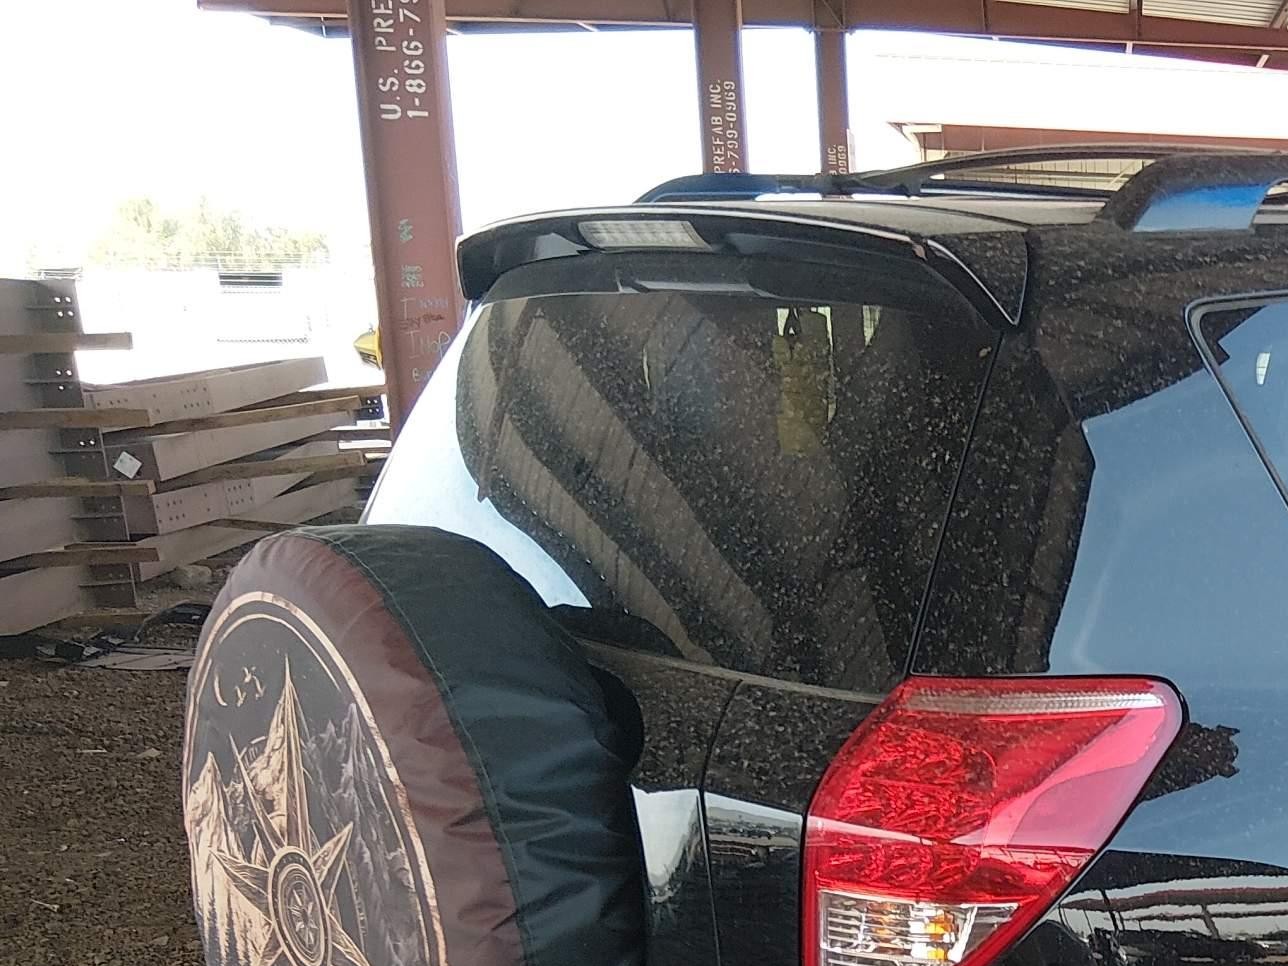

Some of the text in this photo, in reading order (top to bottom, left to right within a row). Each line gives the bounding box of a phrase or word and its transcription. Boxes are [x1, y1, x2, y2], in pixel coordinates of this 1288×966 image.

[378, 69, 402, 120] U.S.
[399, 0, 429, 118] 1-866-7
[709, 79, 725, 174] PREFAB INC.
